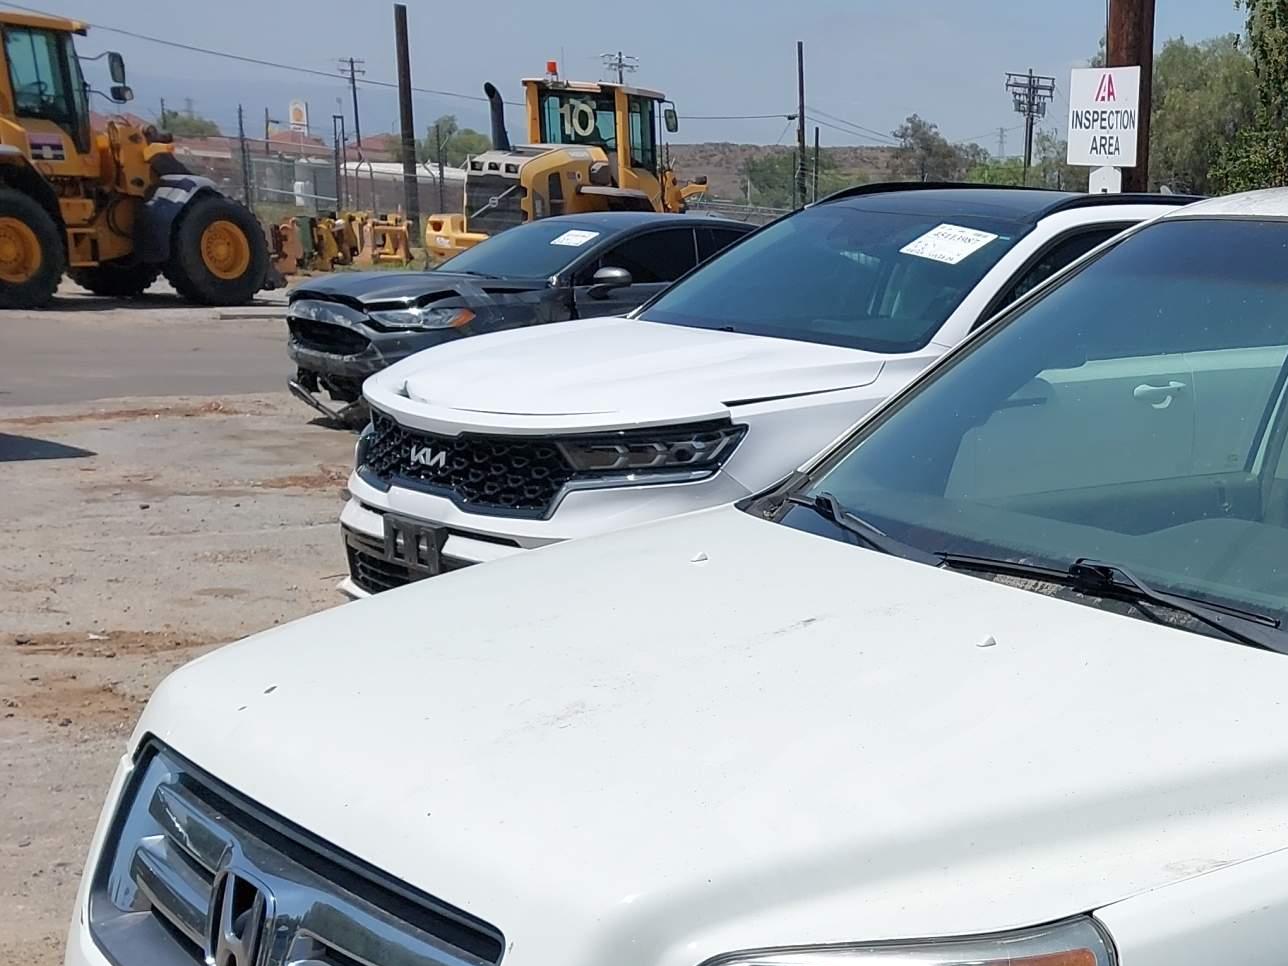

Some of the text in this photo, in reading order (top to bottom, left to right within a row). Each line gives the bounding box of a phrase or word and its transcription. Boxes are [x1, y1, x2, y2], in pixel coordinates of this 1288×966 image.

[1071, 109, 1136, 130] INSPECTION
[1089, 135, 1121, 156] AREA
[410, 444, 446, 469] KIA
